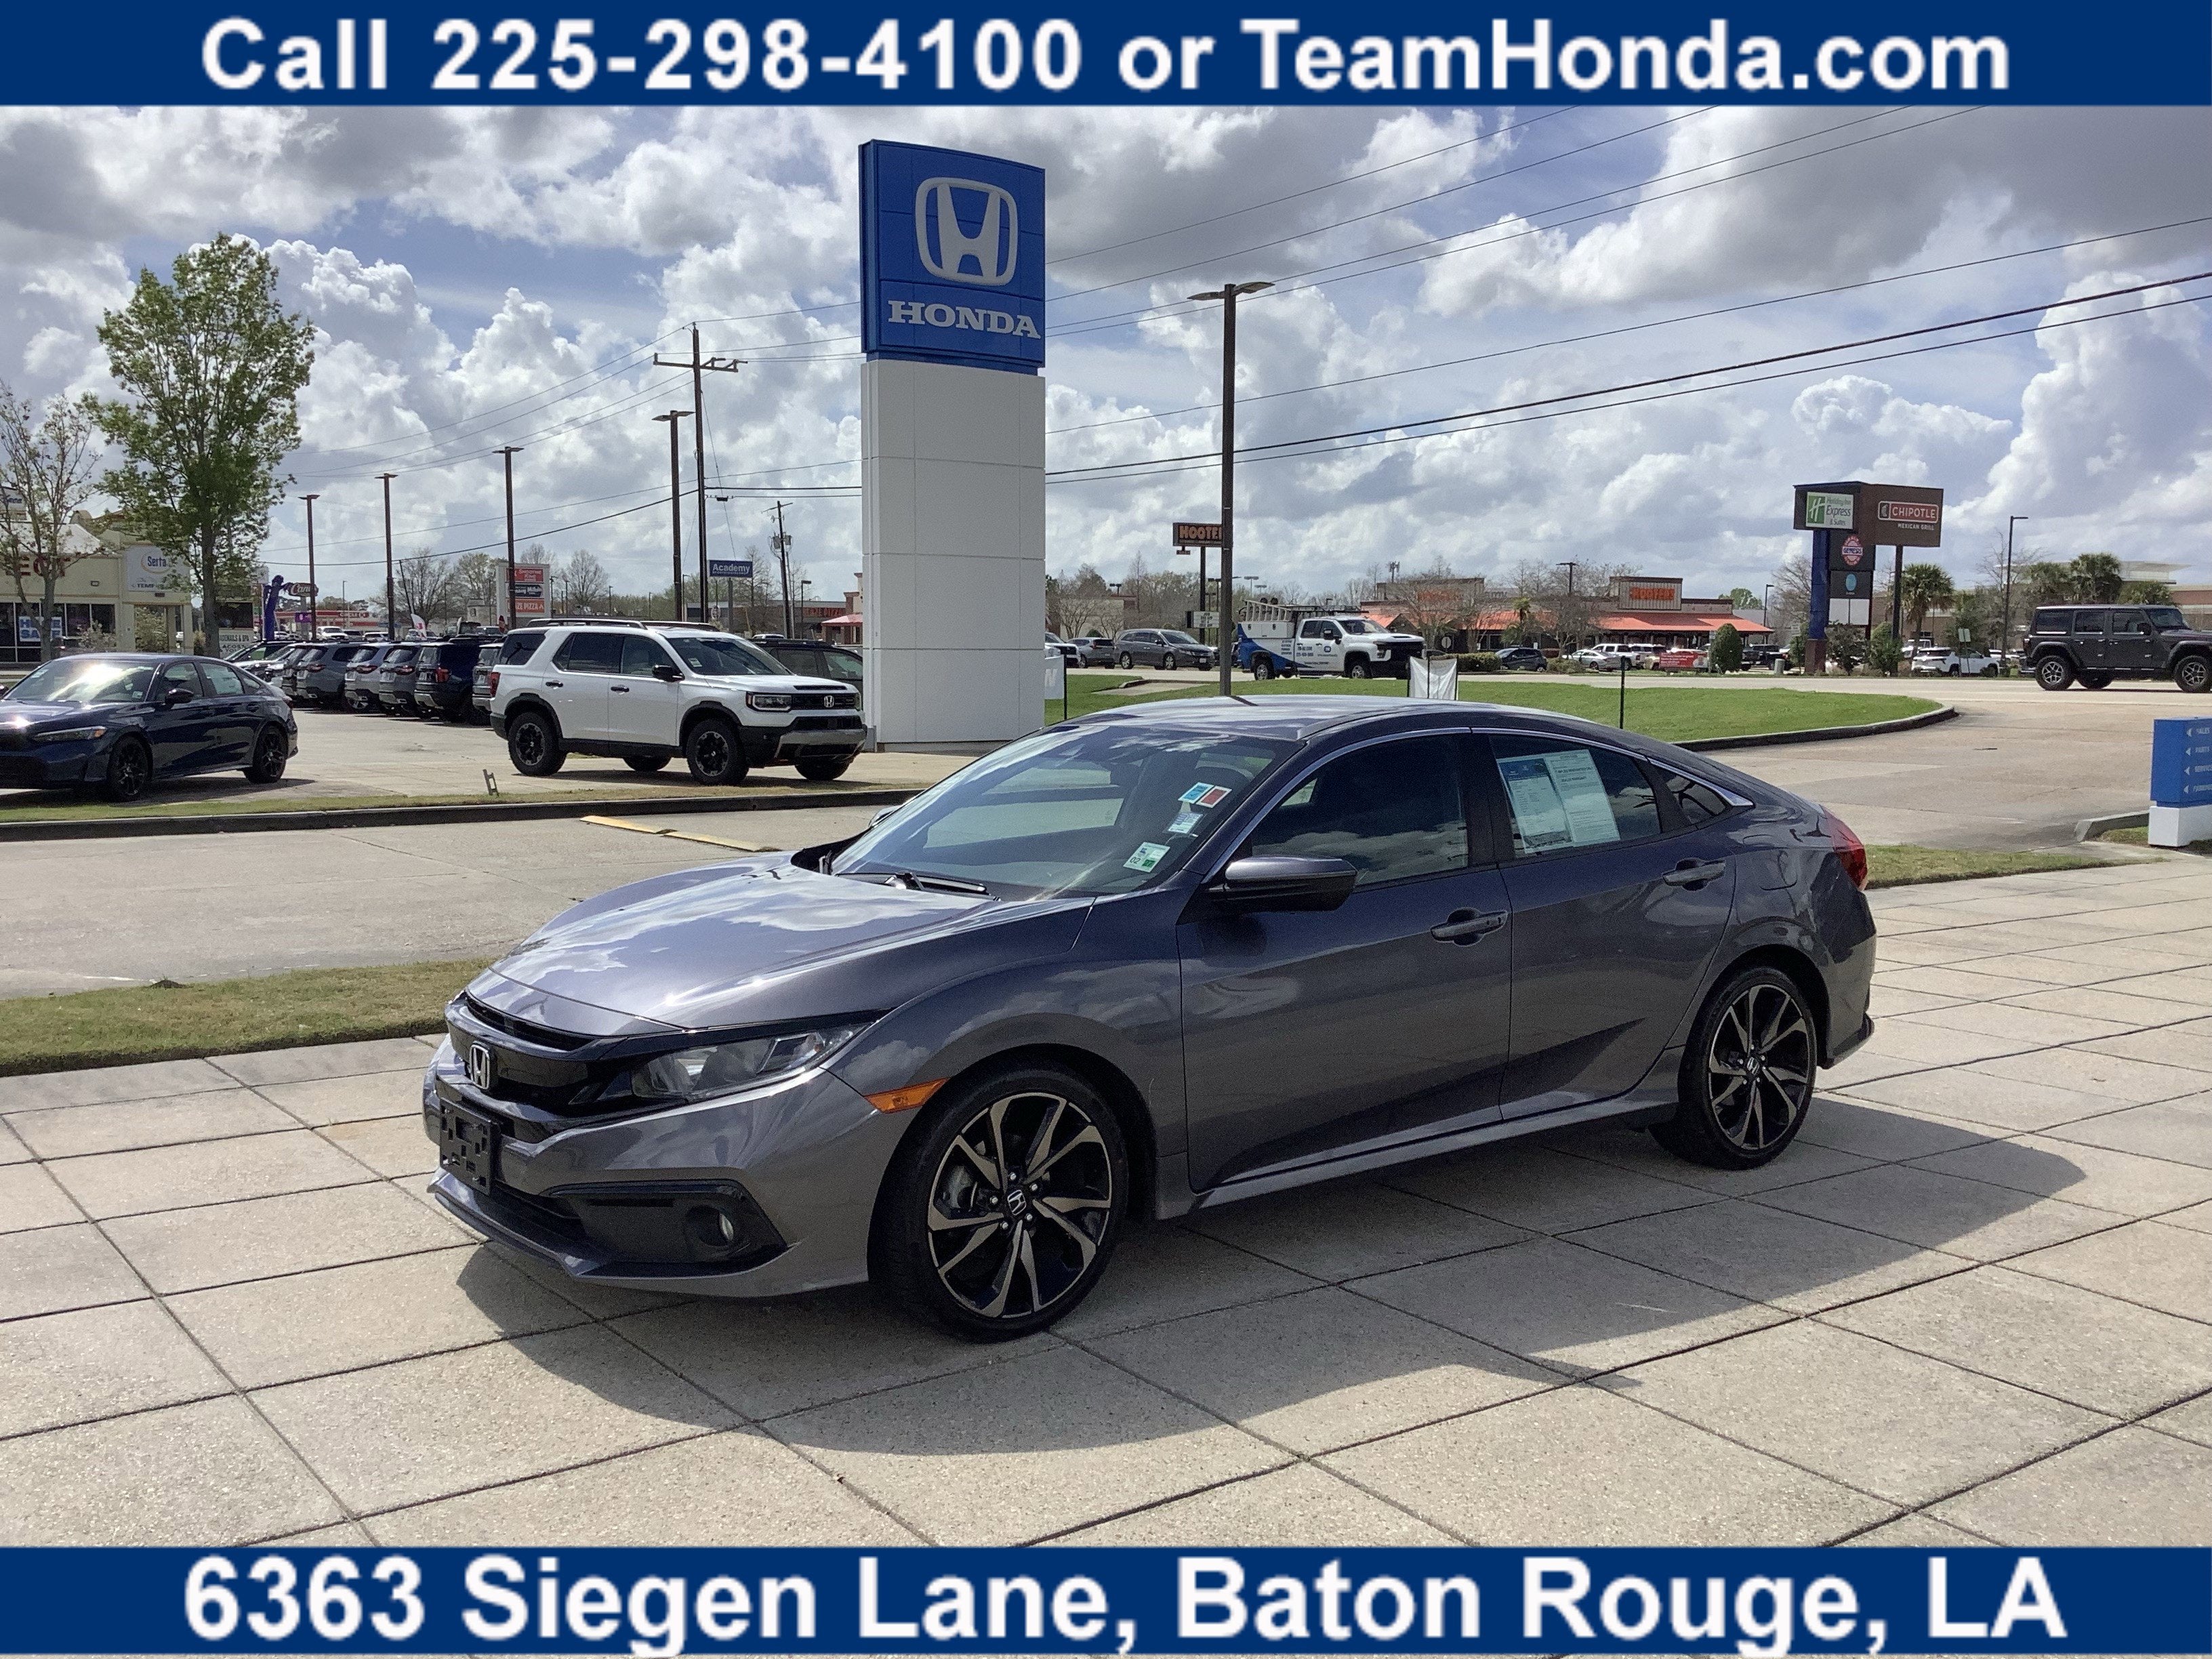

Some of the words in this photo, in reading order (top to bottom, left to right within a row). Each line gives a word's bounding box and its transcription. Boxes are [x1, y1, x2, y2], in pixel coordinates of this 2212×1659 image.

[888, 300, 1042, 340] HONDA
[1826, 505, 1851, 518] Express
[1892, 506, 1936, 518] CHIPOTLE
[147, 556, 167, 567] Serta
[712, 563, 750, 574] Academy
[21, 630, 60, 639] SAE
